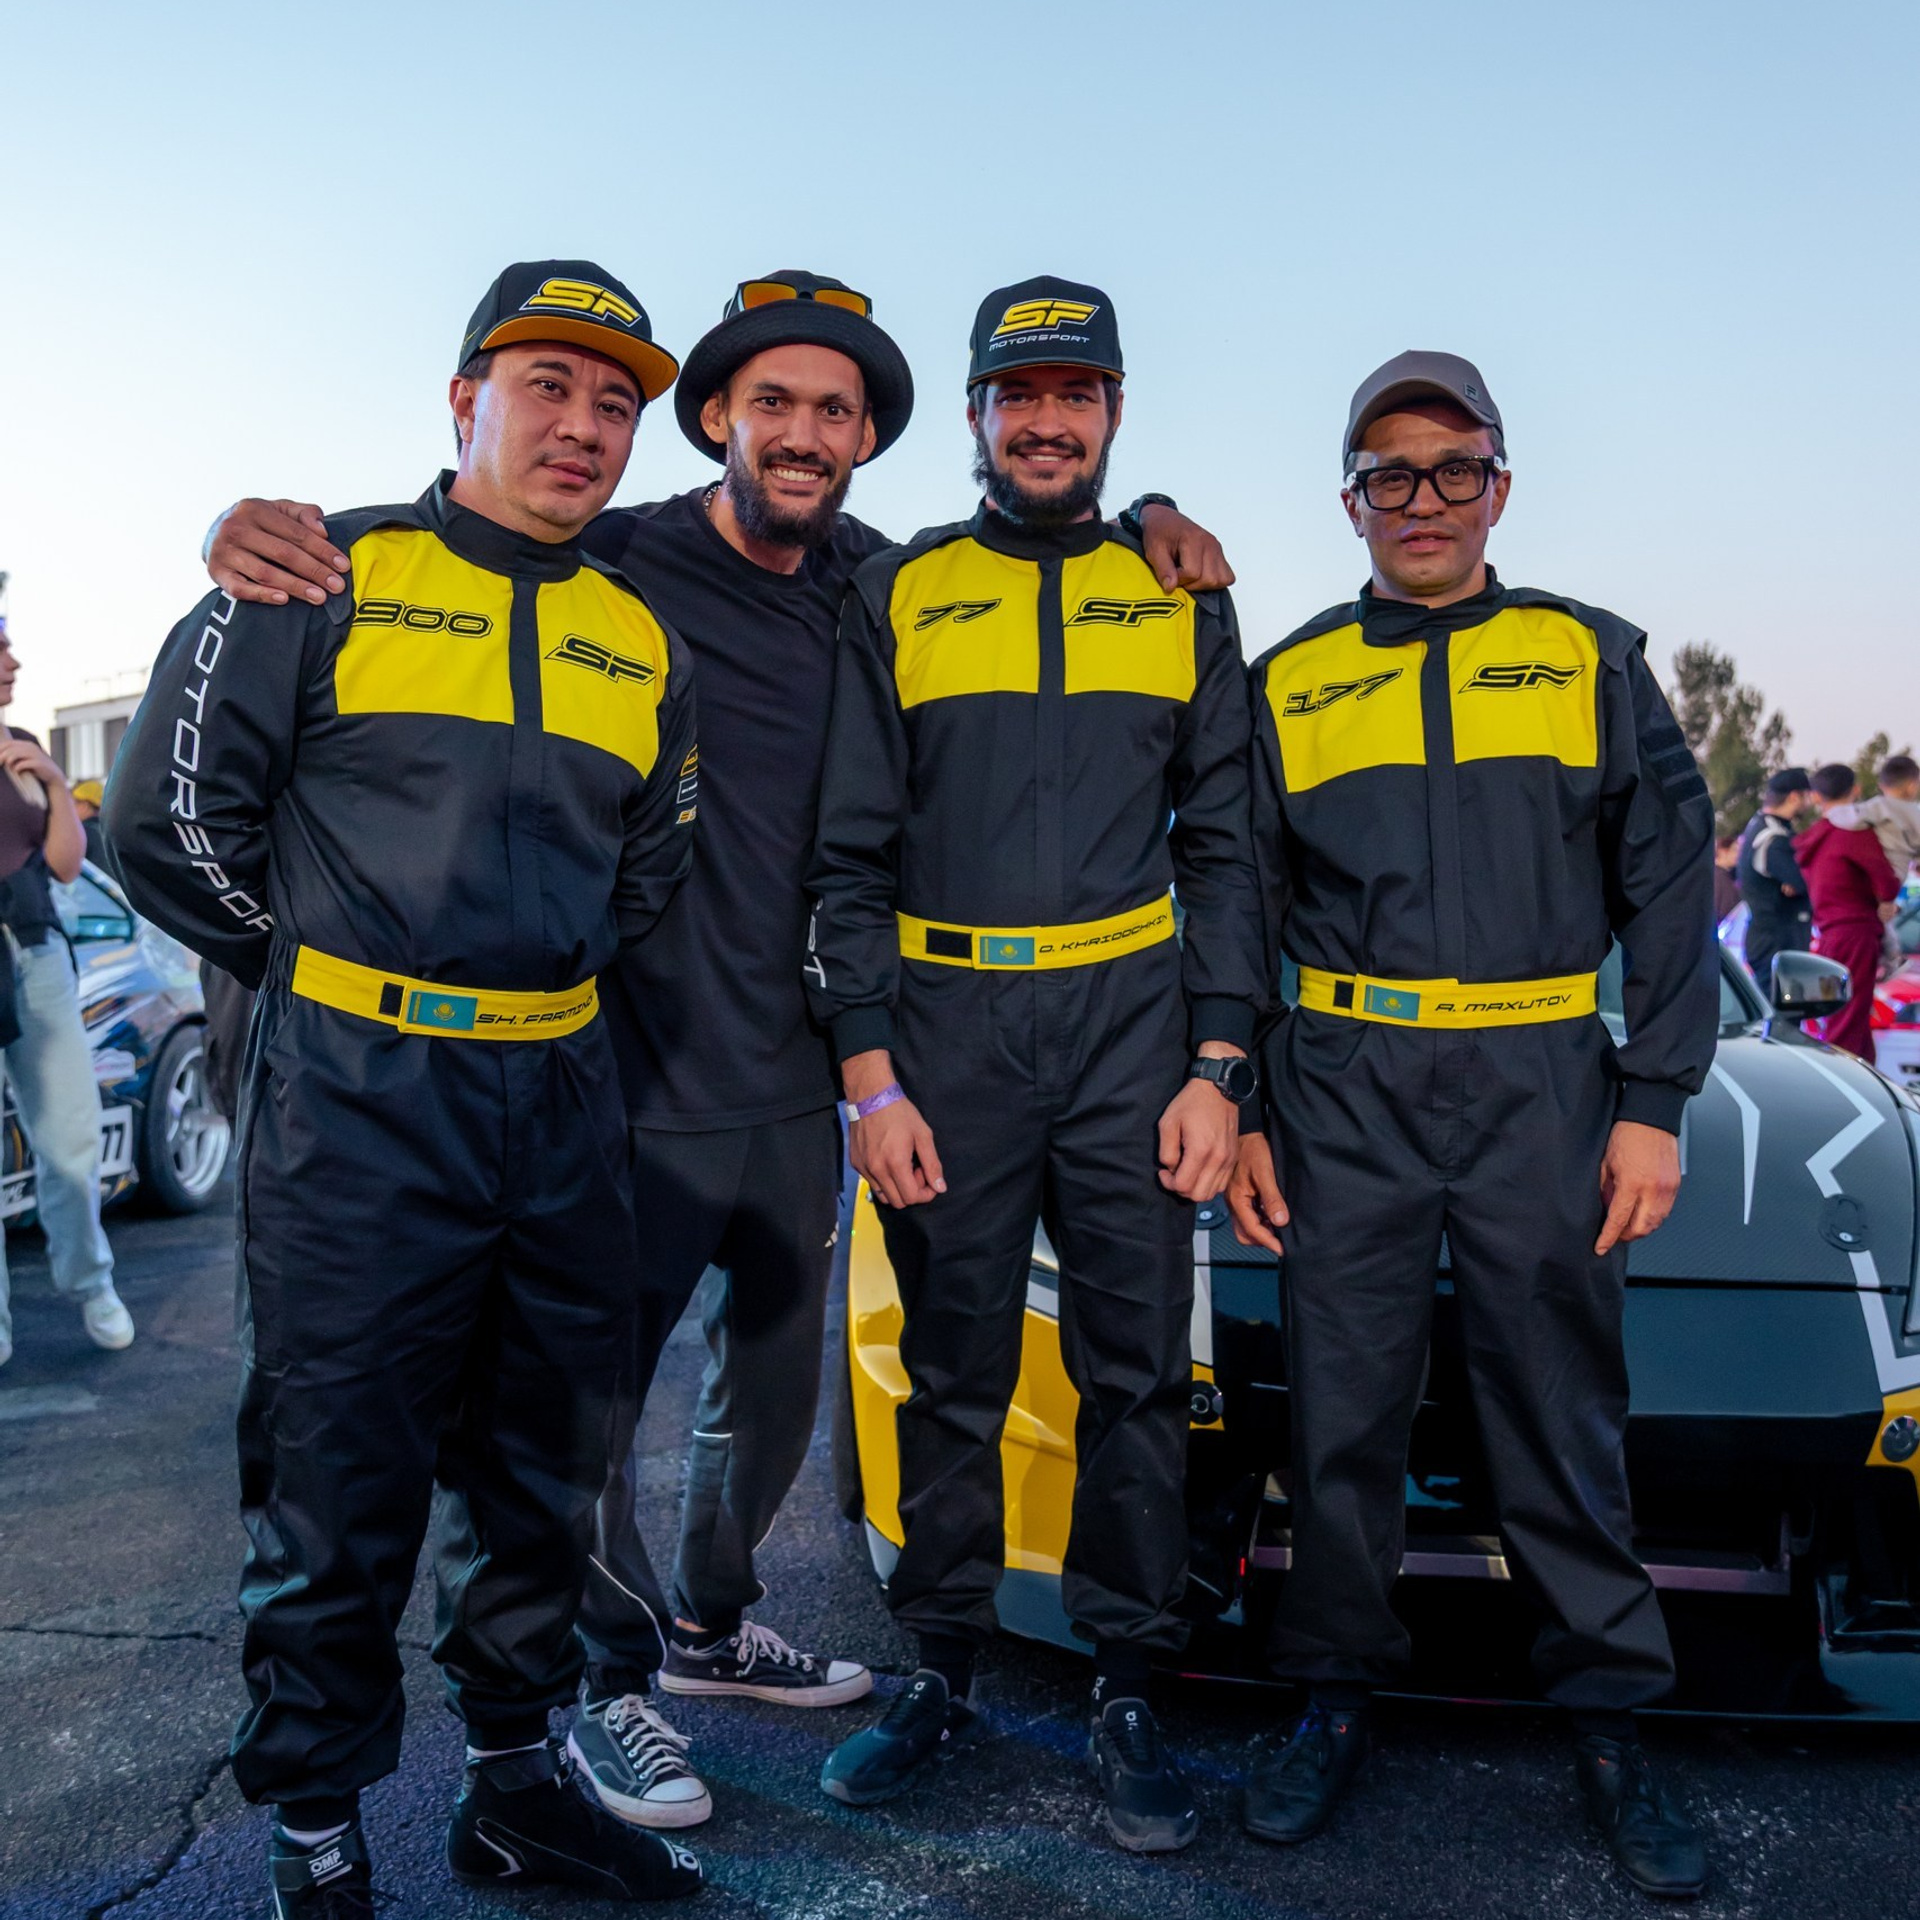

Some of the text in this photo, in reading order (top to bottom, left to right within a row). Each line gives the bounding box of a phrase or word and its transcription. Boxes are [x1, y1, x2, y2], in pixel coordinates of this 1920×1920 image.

[526, 278, 640, 324] SF
[993, 300, 1096, 335] SF
[989, 334, 1090, 352] MOTORSPORT
[353, 599, 493, 638] 900
[915, 599, 1001, 630] 77
[1069, 599, 1181, 625] SF
[551, 635, 655, 682] SF
[1464, 662, 1582, 689] SF
[1284, 669, 1402, 716] 177
[1435, 994, 1572, 1012] A. MAXUTOV
[475, 1013, 517, 1025] SH.
[311, 1851, 341, 1874] OMP
